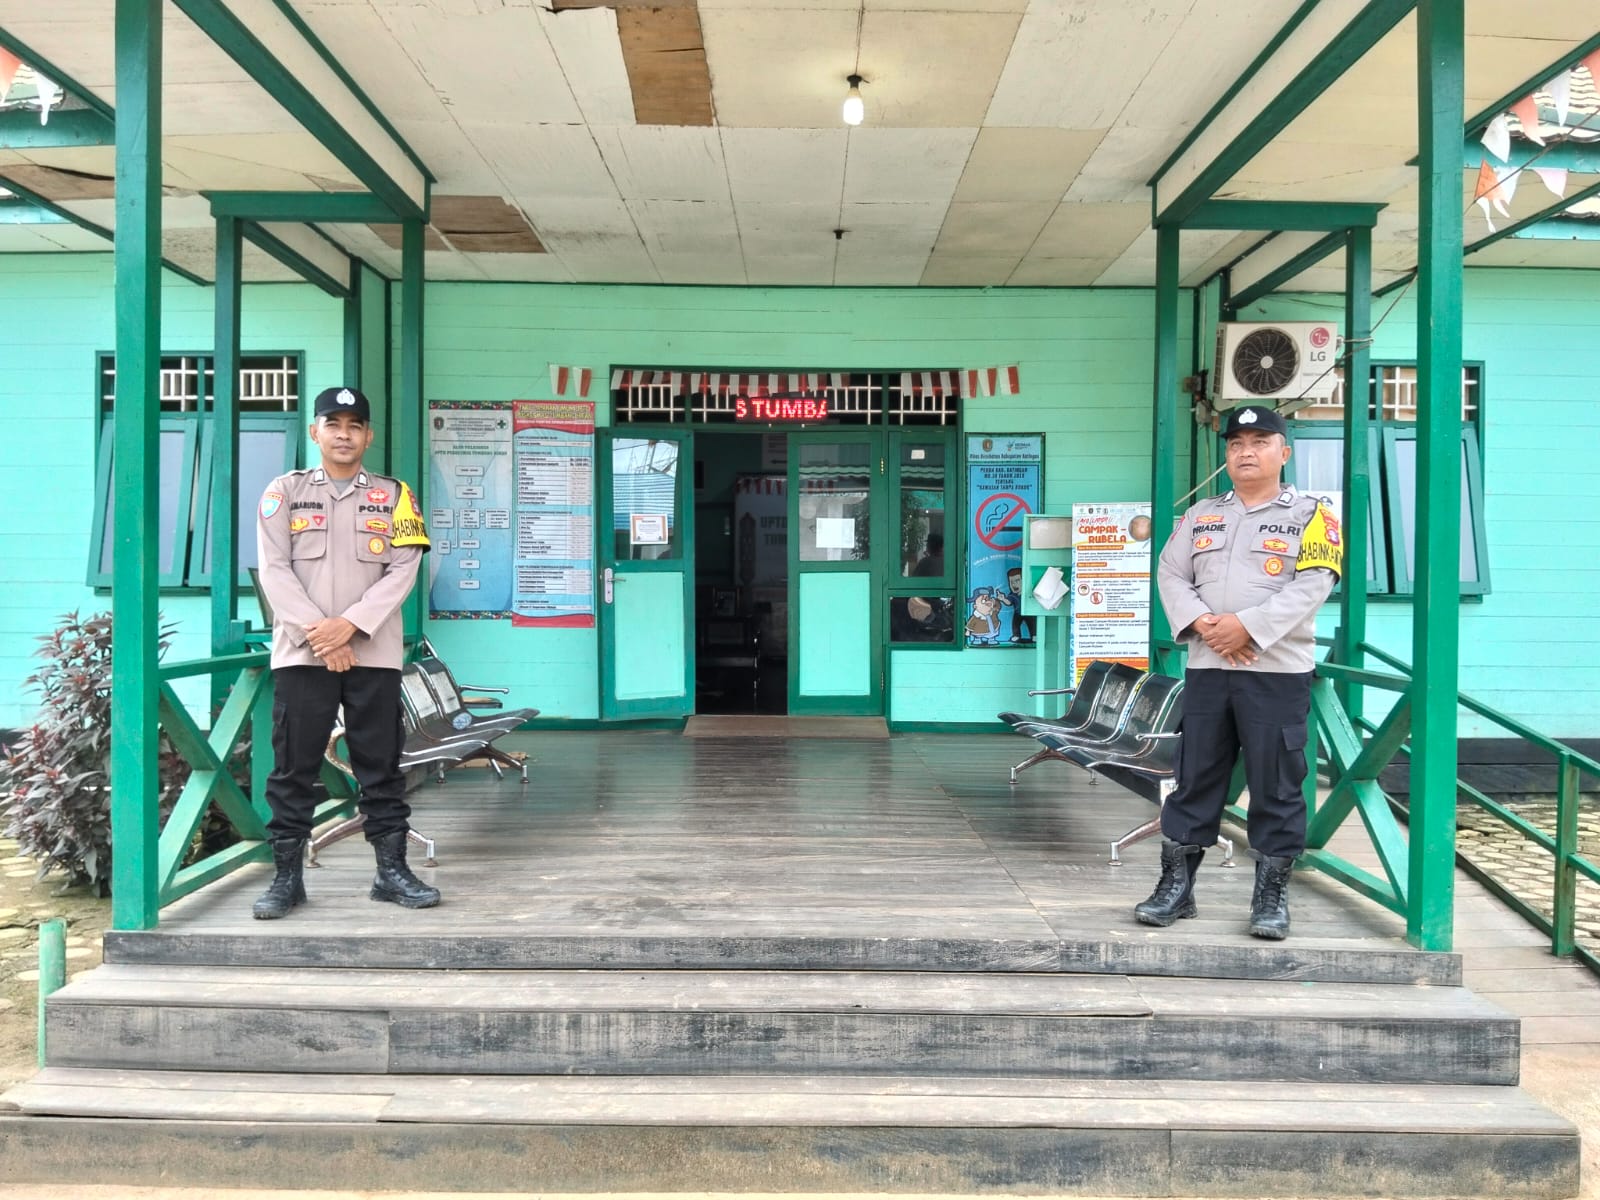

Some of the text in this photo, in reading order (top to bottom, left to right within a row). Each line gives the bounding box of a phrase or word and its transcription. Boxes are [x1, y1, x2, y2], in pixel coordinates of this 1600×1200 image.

[1310, 351, 1326, 362] LG
[358, 505, 393, 515] POLRI
[1078, 525, 1118, 534] CAMPAK
[1258, 524, 1300, 537] POLRI
[1088, 535, 1127, 543] RUBELA
